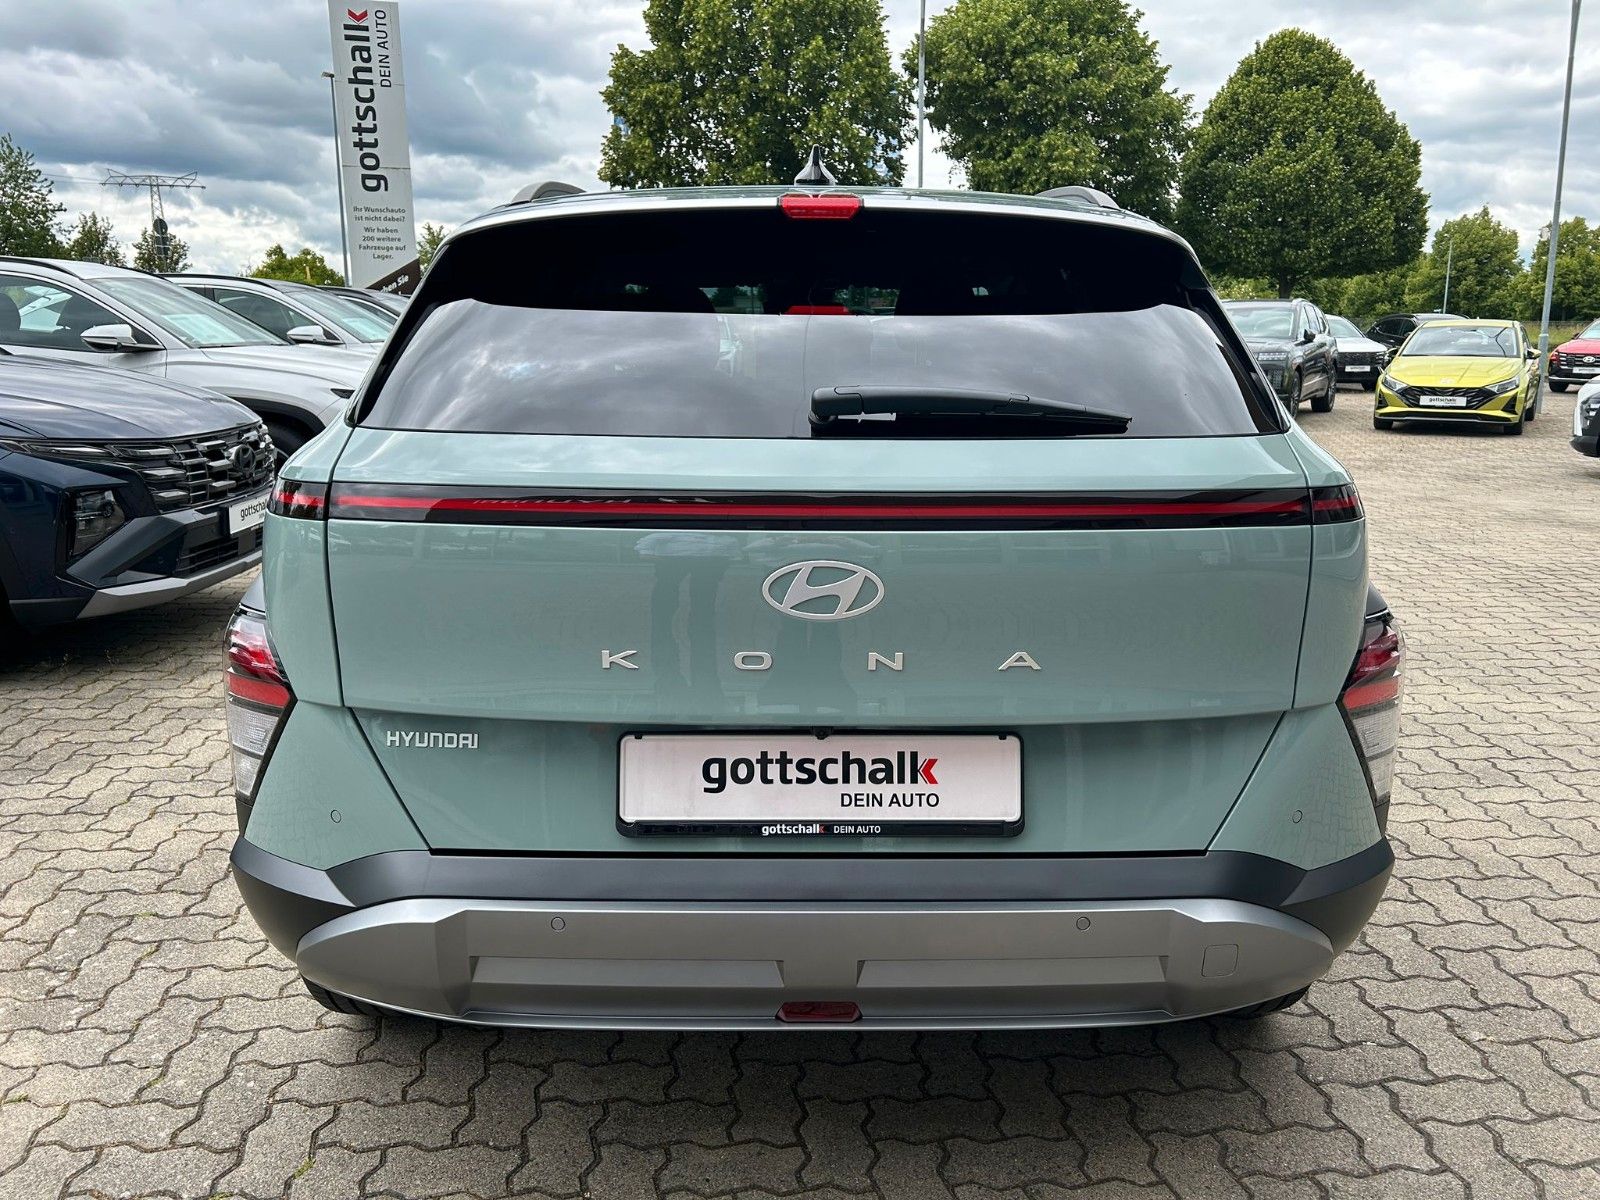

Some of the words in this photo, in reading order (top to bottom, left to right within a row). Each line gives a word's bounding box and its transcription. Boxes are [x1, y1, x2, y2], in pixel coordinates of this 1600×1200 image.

[374, 9, 389, 50] AUTO
[378, 54, 392, 88] DEIN
[343, 9, 389, 192] gottschalk
[364, 206, 406, 214] Wunschauto
[397, 274, 409, 286] Sie
[386, 730, 479, 749] HYUNDAI
[702, 751, 939, 793] gottschalk
[840, 793, 885, 808] DEIN
[888, 793, 940, 808] AUTO
[762, 823, 825, 836] gottschalk
[833, 825, 854, 834] DEIN
[856, 825, 881, 834] AUTO
